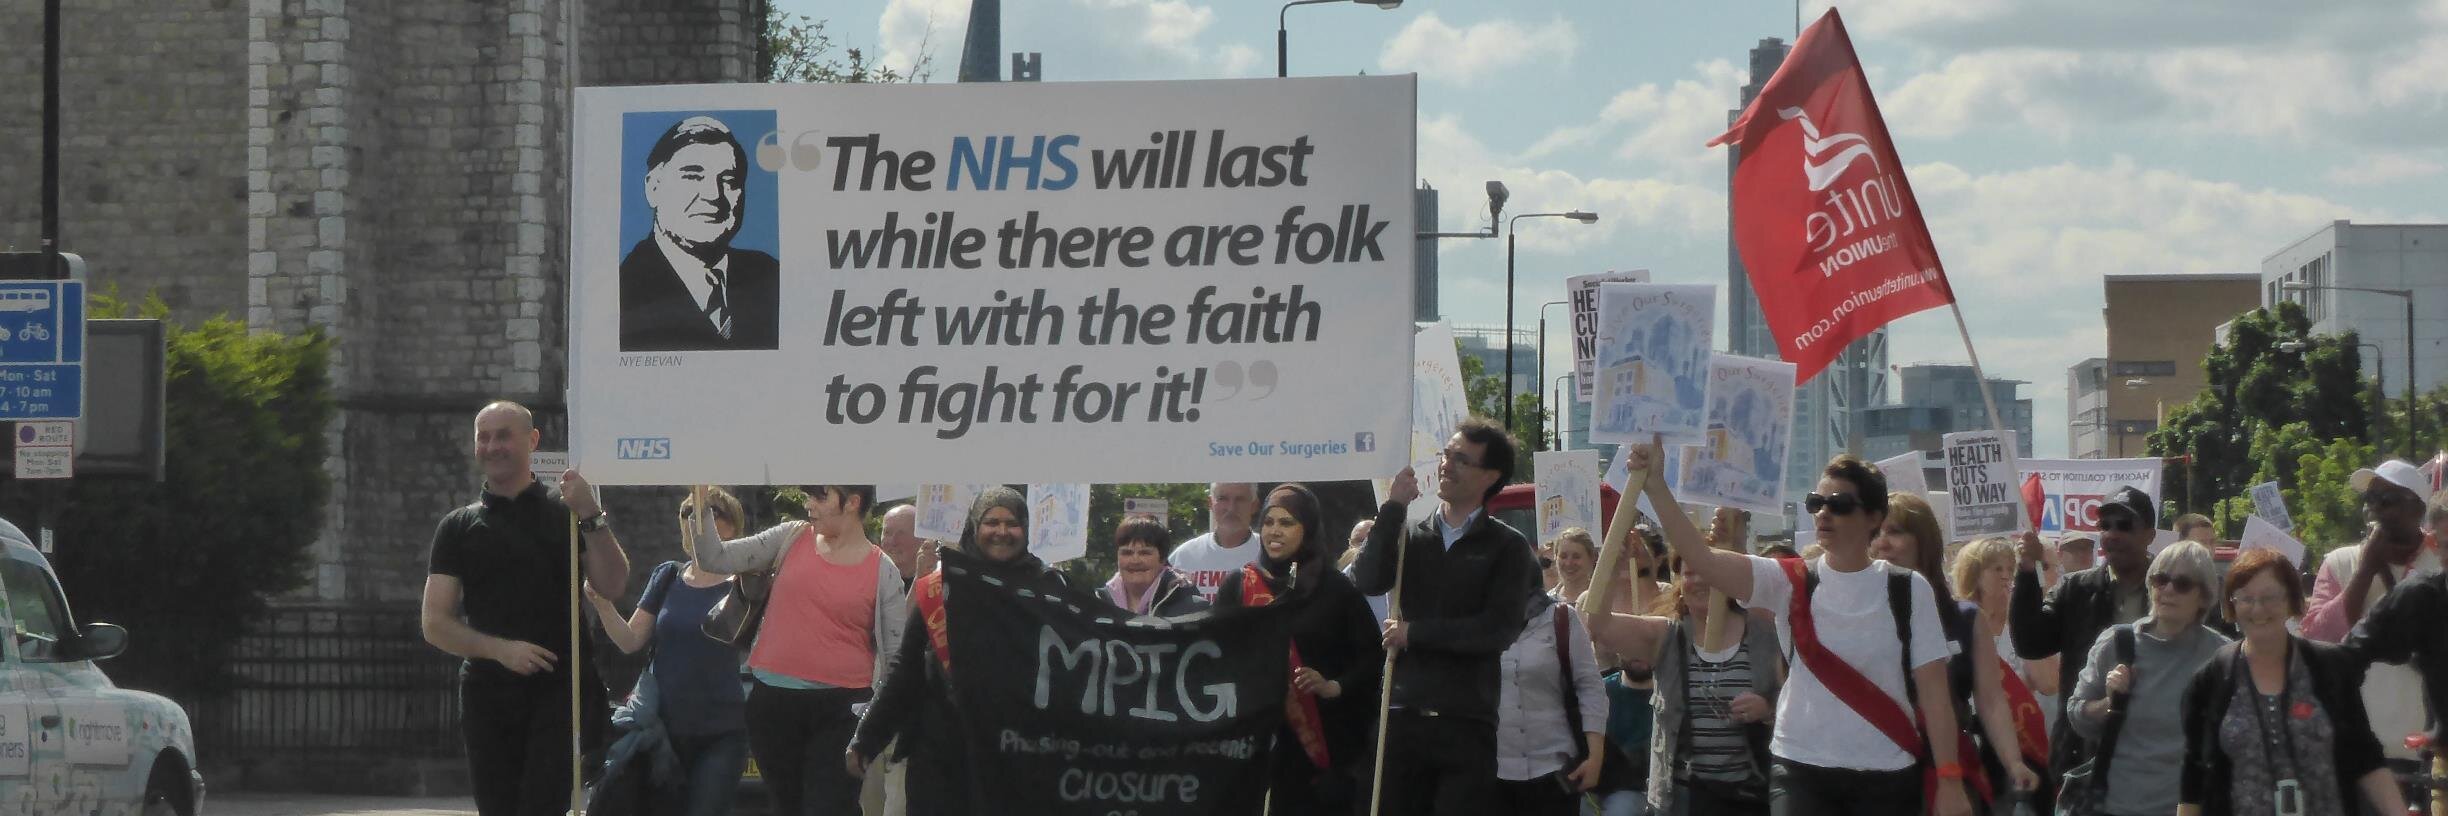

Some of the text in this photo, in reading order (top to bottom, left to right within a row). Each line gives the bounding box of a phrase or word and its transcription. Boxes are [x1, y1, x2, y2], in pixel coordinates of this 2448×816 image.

[946, 134, 1080, 191] NHS
[1092, 130, 1197, 189] will
[1203, 129, 1314, 188] last
[826, 204, 1391, 269] while there are folk
[823, 284, 1321, 346] left with the faith
[619, 355, 684, 368] NYE BEVAN
[34, 369, 57, 381] Sat
[825, 373, 887, 424] to
[898, 365, 1044, 440] fight
[1052, 364, 1141, 423] for
[618, 438, 670, 459] NHS
[1209, 442, 1243, 457] Save
[1248, 441, 1275, 456] Our
[1279, 438, 1348, 459] Surgeries
[1948, 443, 2002, 466] HEALTH
[1950, 464, 1988, 486] CUTS
[1952, 482, 2007, 506] NO WAY
[1034, 624, 1237, 723] MPIG
[1057, 766, 1200, 803] Closure
